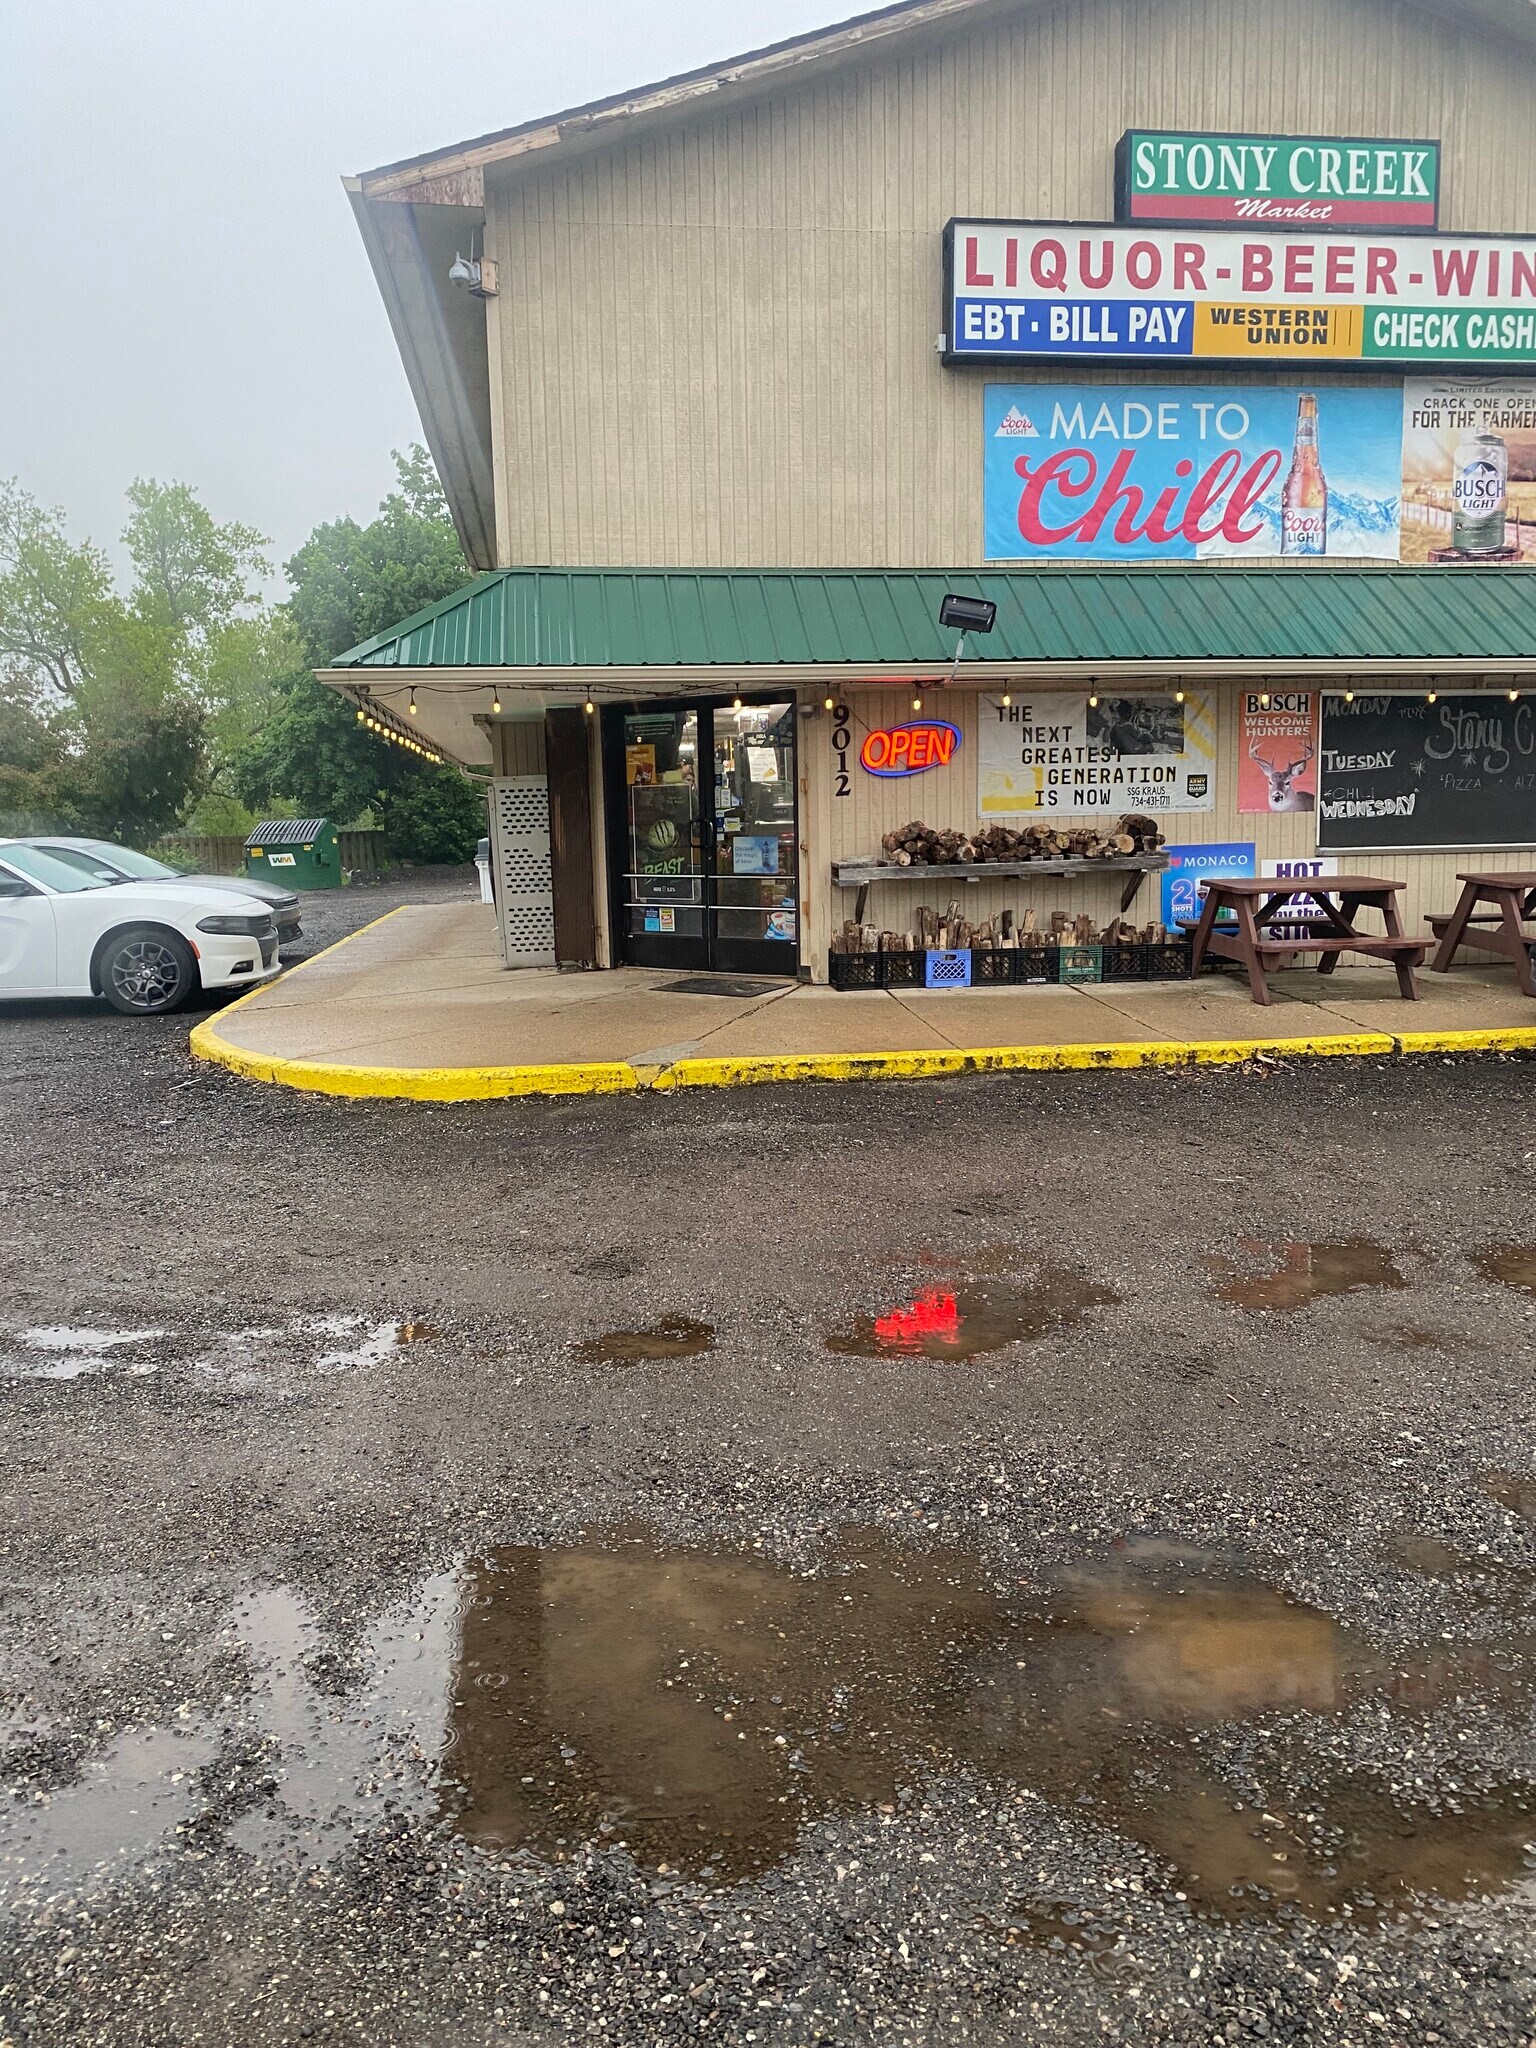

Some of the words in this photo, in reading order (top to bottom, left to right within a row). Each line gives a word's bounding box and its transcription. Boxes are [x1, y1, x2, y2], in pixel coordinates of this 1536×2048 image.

[1136, 141, 1278, 191] STONY
[1288, 146, 1430, 196] CREEK
[1234, 198, 1333, 219] Market
[964, 304, 1025, 341] EBT
[1050, 306, 1118, 342] BILL
[1128, 306, 1187, 343] PAY
[1210, 307, 1329, 326] WESTERN
[1247, 327, 1328, 345] UNION
[1373, 312, 1461, 348] CHECK
[1466, 314, 1536, 349] CASH
[1423, 398, 1466, 409] CRACK
[1473, 398, 1499, 409] ONE
[1001, 414, 1033, 429] Coors
[1050, 402, 1180, 440] MADE
[1192, 402, 1249, 440] TO
[1412, 410, 1440, 428] FOR
[1448, 410, 1476, 428] THE
[1006, 428, 1028, 436] LIGHT
[1014, 448, 1282, 545] Chill
[1455, 480, 1506, 498] BUSCH
[1462, 500, 1496, 508] LIGHT
[1288, 532, 1320, 543] LIGHT
[1246, 693, 1309, 713] BUSCH
[1323, 696, 1392, 718] MONDAY
[996, 705, 1032, 722] THE
[1244, 716, 1312, 726] WELCOME
[1022, 726, 1072, 743] NEXT
[1246, 726, 1310, 737] HUNTERS
[1424, 705, 1510, 774] Stony
[832, 704, 851, 797] 9012
[861, 729, 953, 769] OPEN
[1021, 746, 1122, 765] GREATEST
[1322, 749, 1396, 770] TUESDAY
[1048, 766, 1177, 785] GENERATION
[1444, 772, 1482, 788] PIZZA
[1034, 790, 1058, 807] IS
[1073, 788, 1111, 806] NOW
[1127, 787, 1140, 796] SSG
[1142, 786, 1166, 795] KRAUS
[1320, 793, 1416, 818] WEDNESDAY
[271, 856, 292, 864] WM
[1183, 854, 1248, 868] MONACO
[1171, 878, 1194, 906] 2
